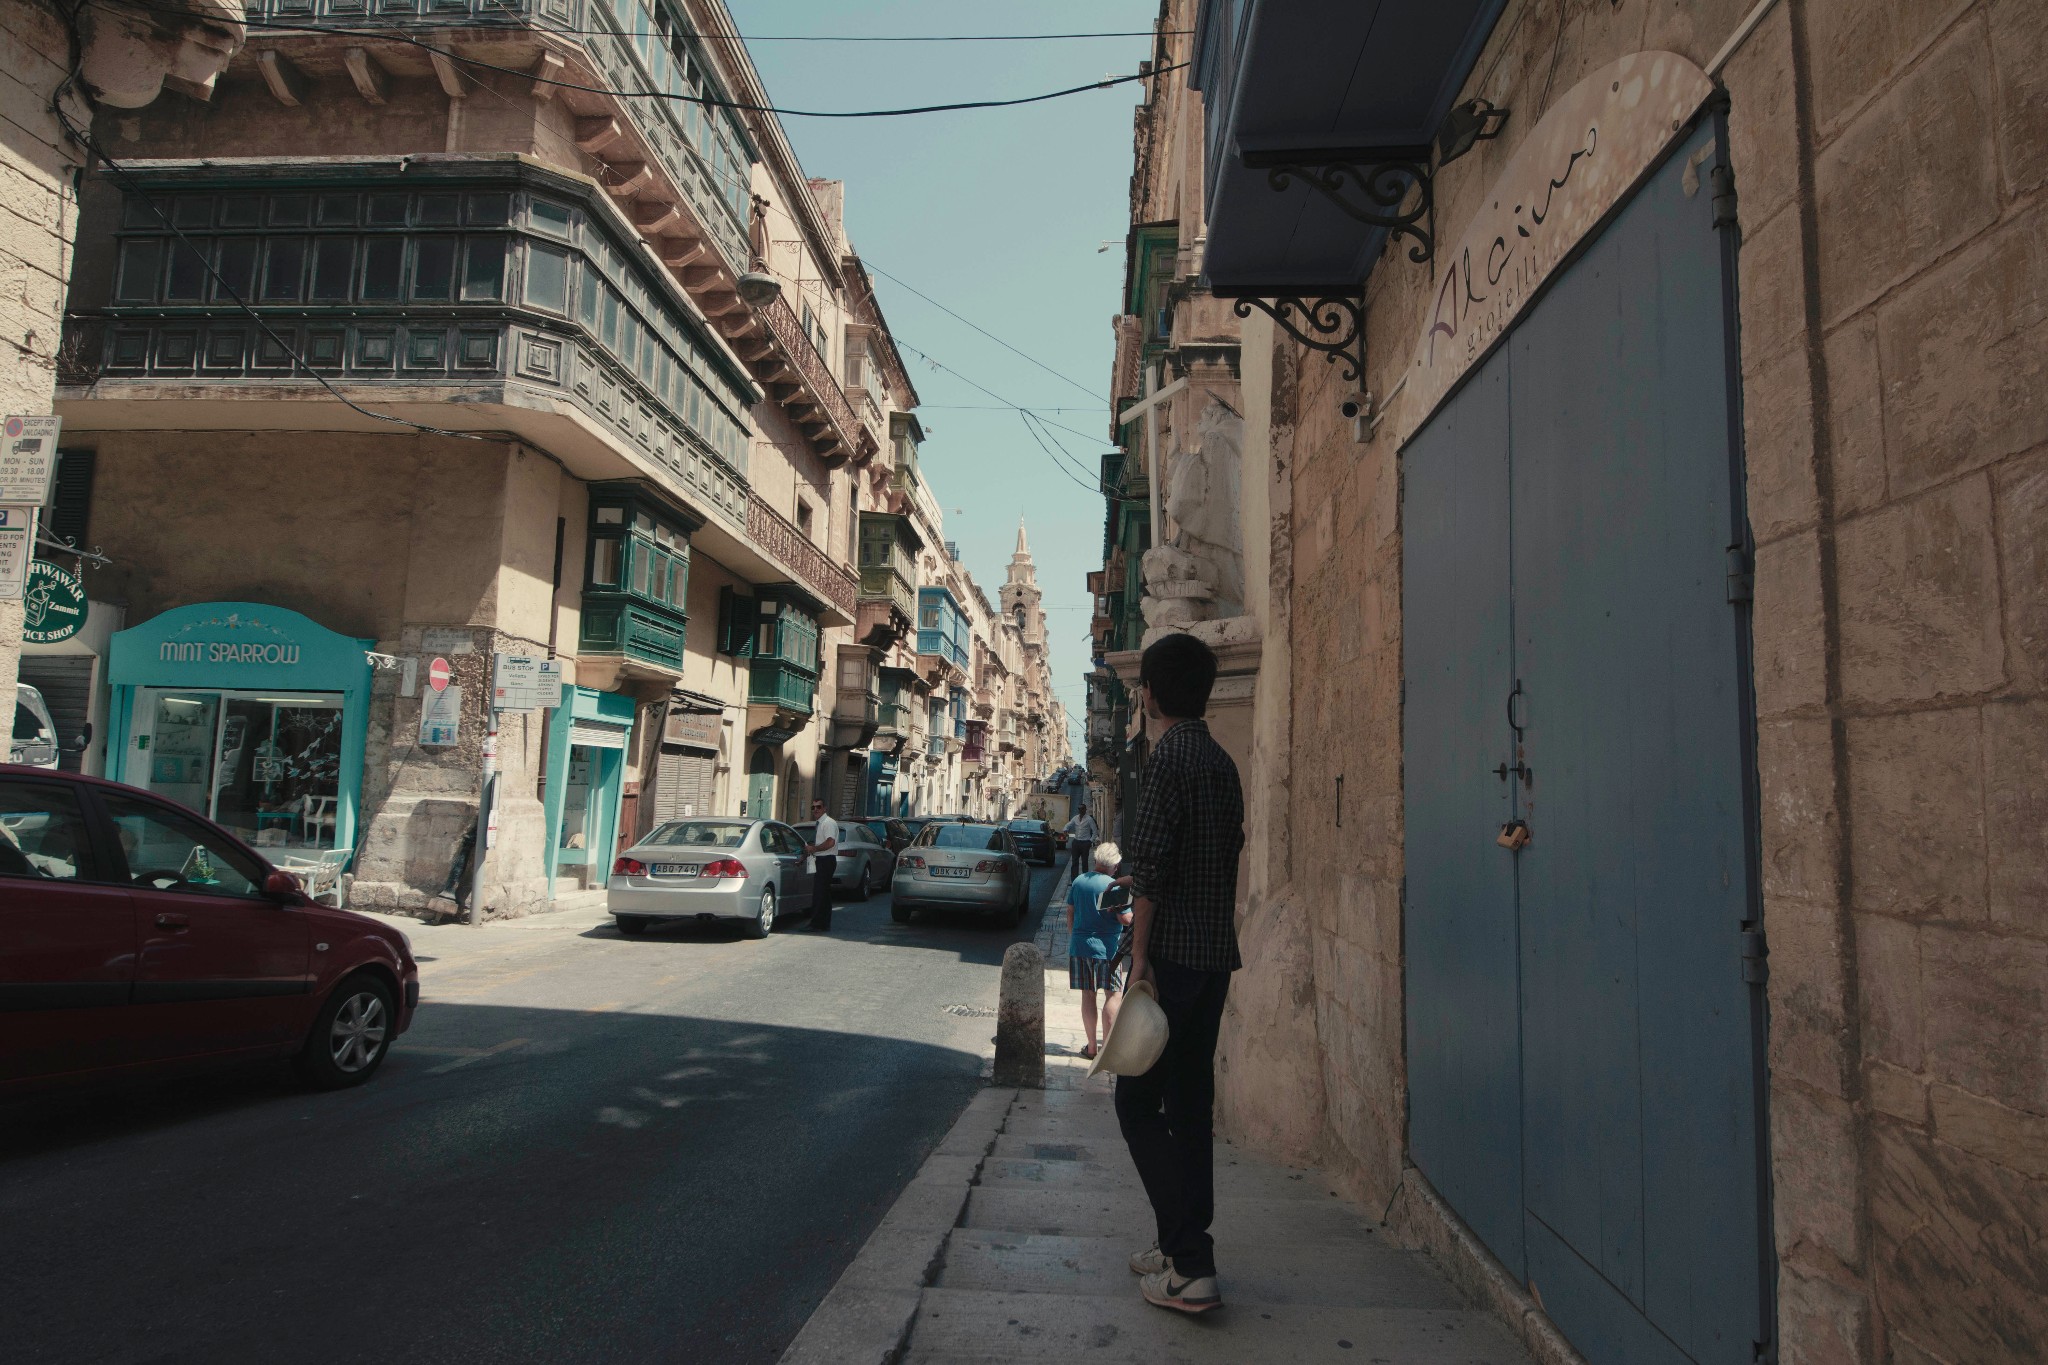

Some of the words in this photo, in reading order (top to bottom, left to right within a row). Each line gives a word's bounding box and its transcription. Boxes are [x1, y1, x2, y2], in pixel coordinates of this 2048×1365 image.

[1466, 245, 1537, 361] gioielli
[24, 419, 44, 427] EXCEPT
[44, 419, 56, 427] FOR
[28, 457, 45, 465] SUN
[27, 467, 45, 475] 18.00
[19, 476, 46, 484] MINUTES
[48, 601, 80, 616] Zammit
[47, 624, 74, 641] SHOP
[159, 641, 205, 662] MINT
[208, 642, 301, 664] SPARROW
[678, 865, 696, 873] 746
[953, 868, 968, 877] 491
